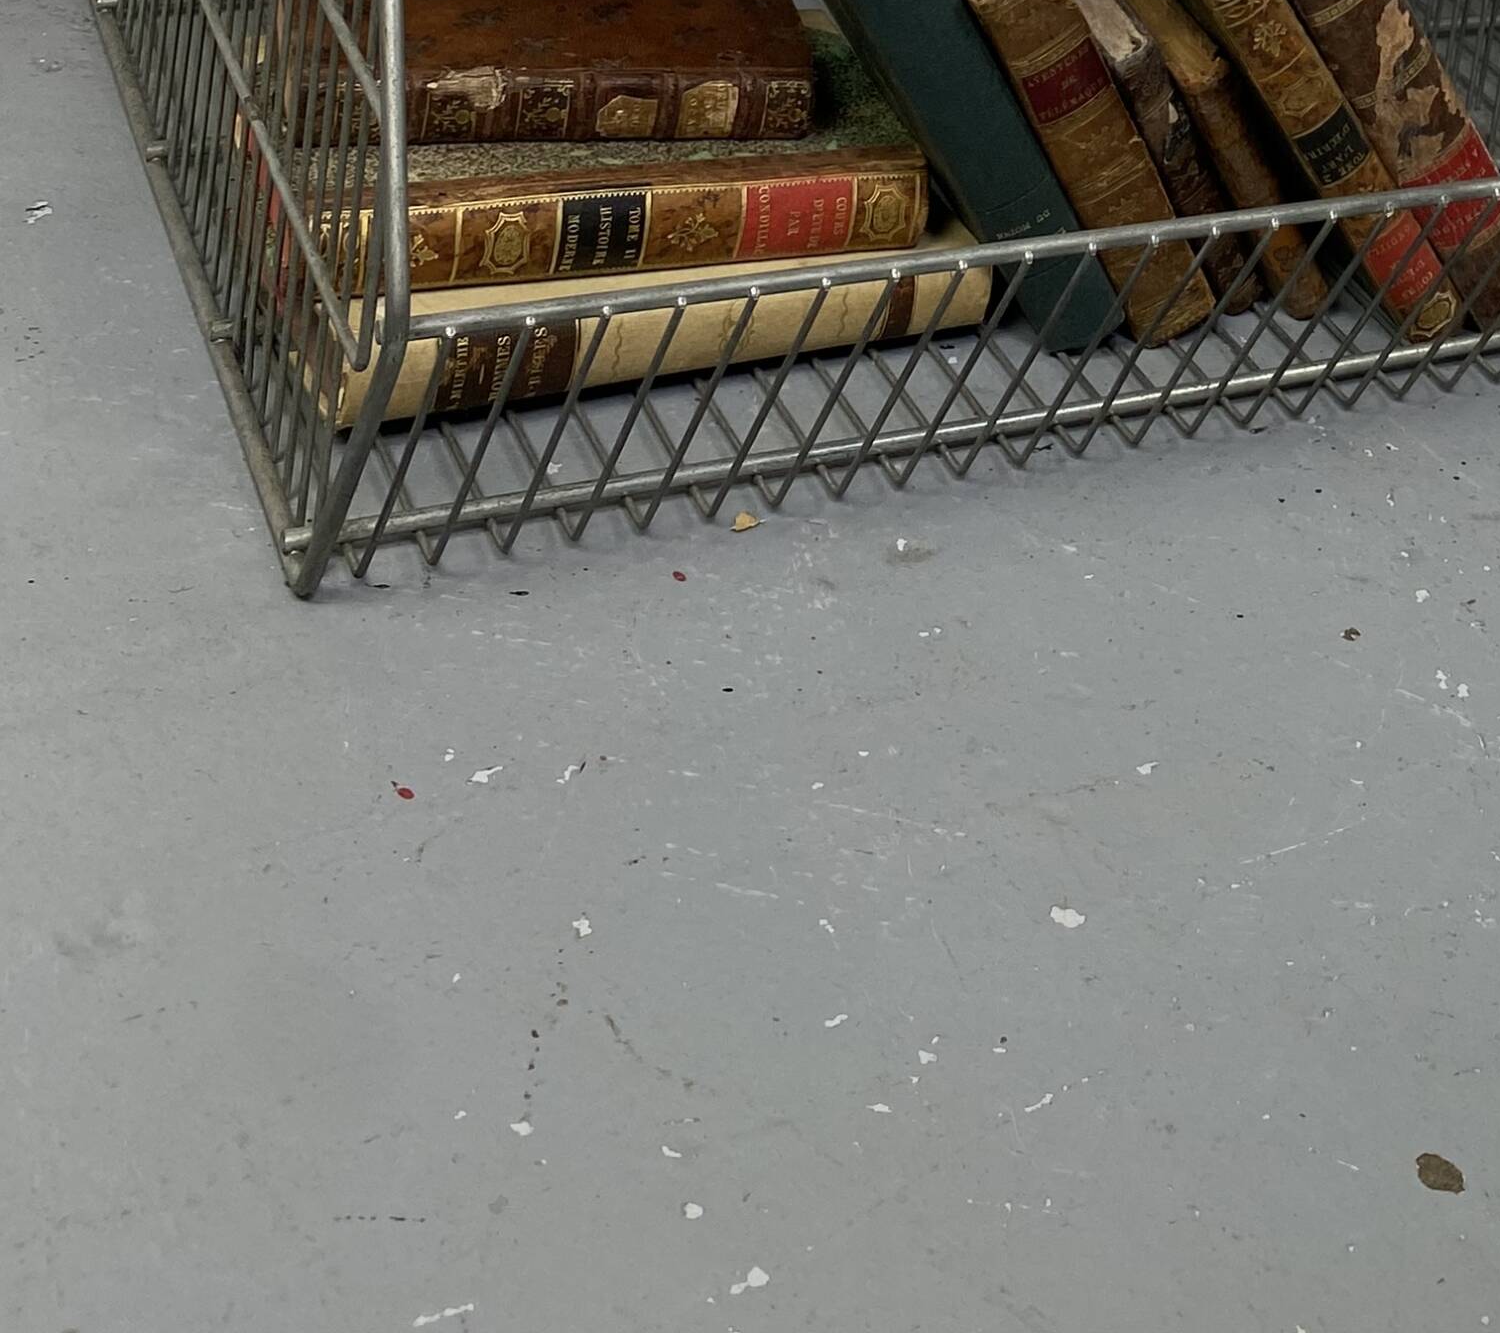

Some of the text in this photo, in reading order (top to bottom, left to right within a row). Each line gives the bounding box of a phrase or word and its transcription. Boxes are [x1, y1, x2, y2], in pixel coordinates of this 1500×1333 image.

[558, 214, 581, 271] MODERNE
[592, 205, 613, 266] HISTOIRE
[626, 206, 641, 243] TOME
